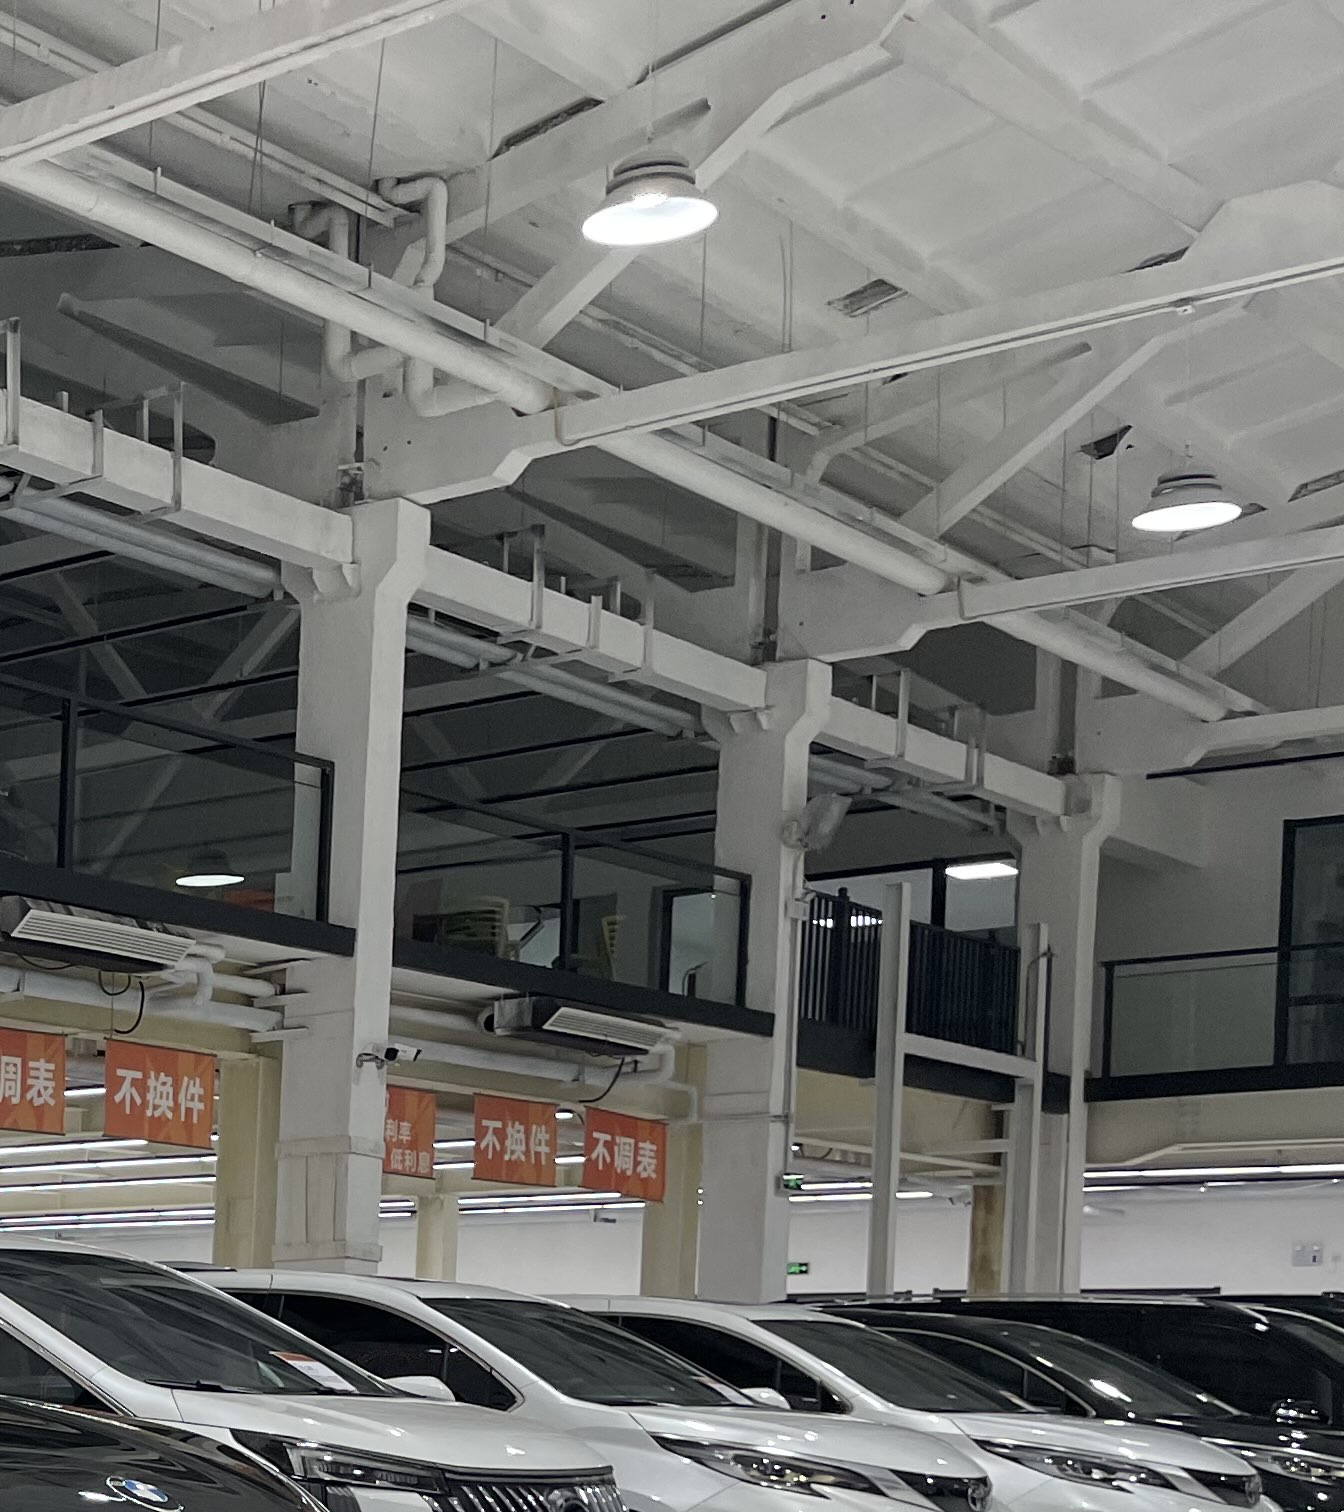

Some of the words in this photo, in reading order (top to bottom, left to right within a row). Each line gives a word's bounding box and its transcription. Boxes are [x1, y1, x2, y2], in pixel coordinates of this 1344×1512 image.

[114, 1068, 205, 1123] 不换件
[480, 1119, 550, 1166] 不换件
[591, 1131, 657, 1180] 不调表
